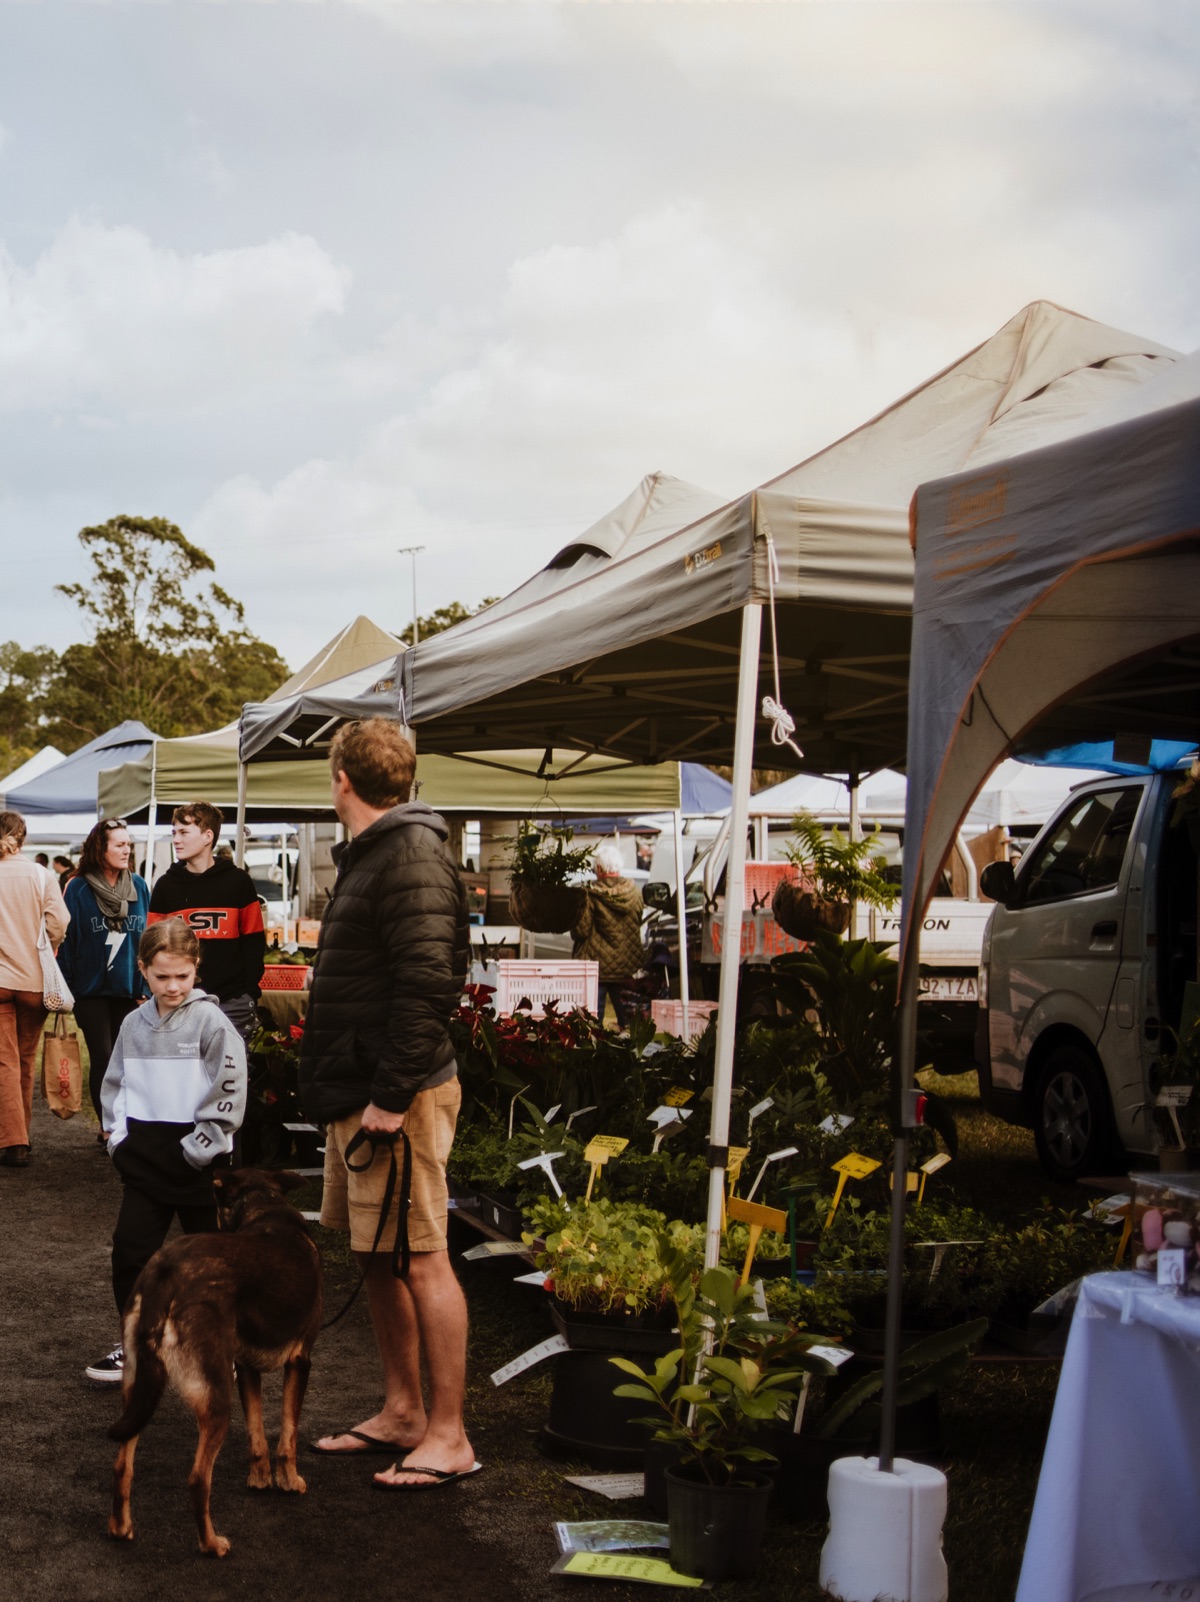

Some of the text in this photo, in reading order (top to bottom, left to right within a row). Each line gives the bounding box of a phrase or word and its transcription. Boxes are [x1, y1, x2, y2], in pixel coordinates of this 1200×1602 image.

[90, 914, 145, 933] LV
[881, 918, 951, 931] TRON
[57, 1058, 70, 1099] coles
